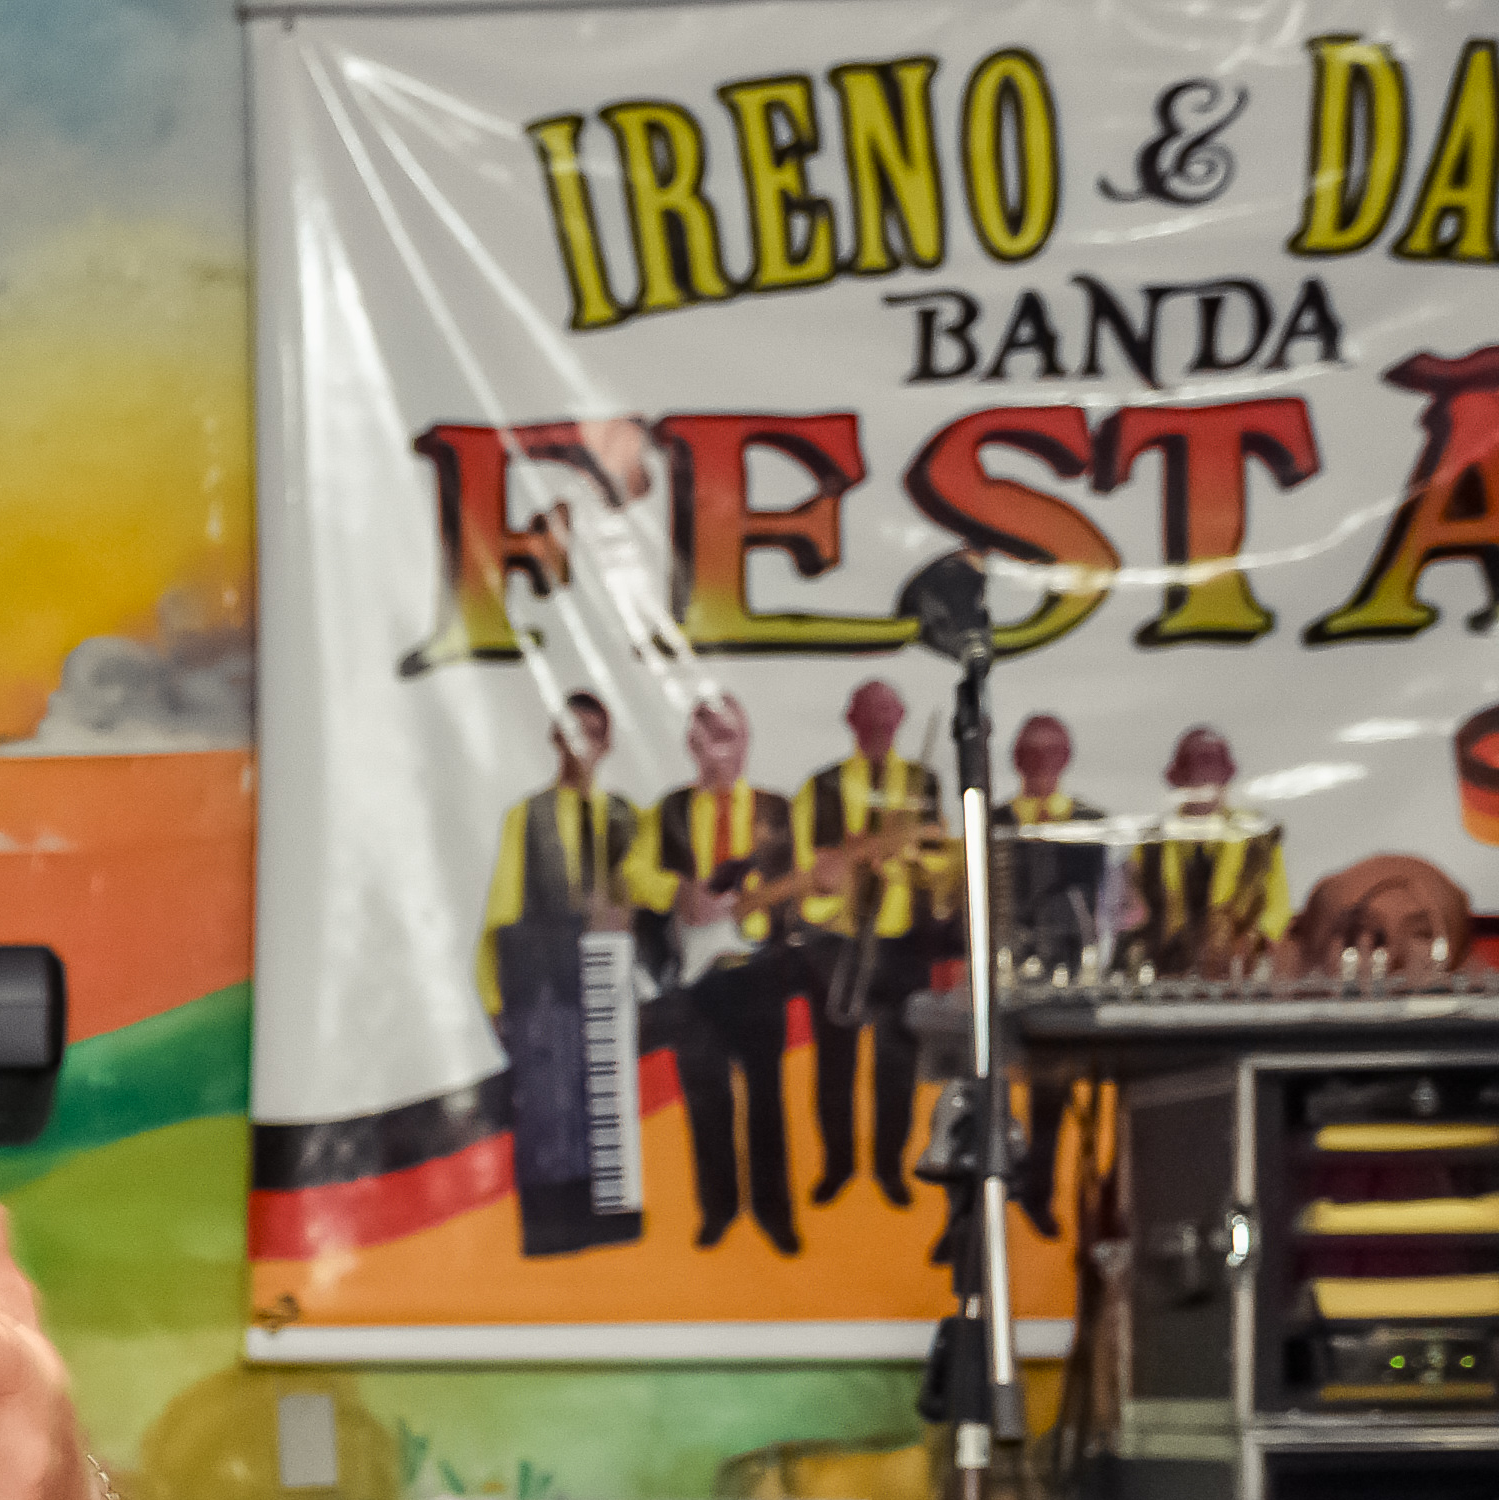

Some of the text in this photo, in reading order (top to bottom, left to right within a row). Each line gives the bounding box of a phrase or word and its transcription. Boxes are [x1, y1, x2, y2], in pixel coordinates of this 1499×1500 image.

[525, 35, 1499, 331] IRENO & DA
[882, 273, 1344, 390] BANDA
